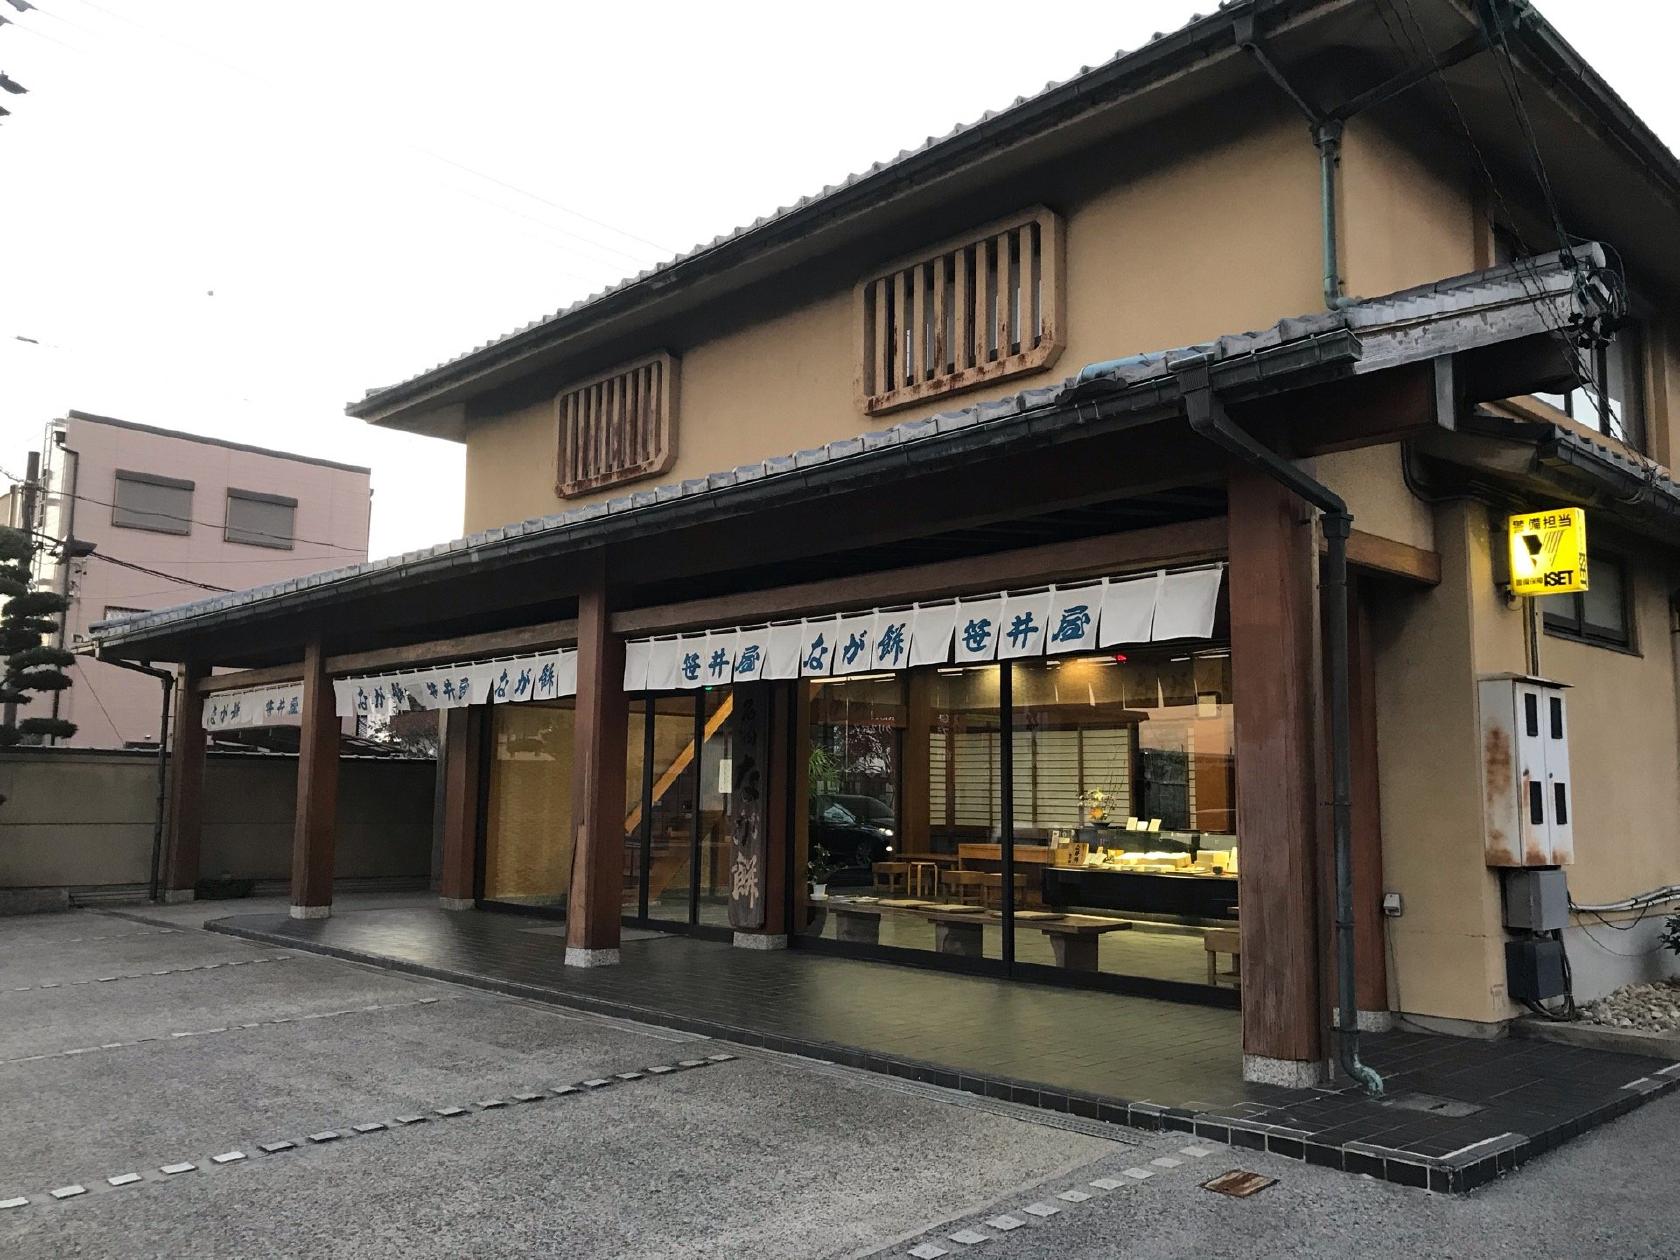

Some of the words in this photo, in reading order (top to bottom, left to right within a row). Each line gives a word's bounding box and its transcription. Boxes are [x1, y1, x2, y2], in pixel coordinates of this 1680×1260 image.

[1544, 570, 1574, 587] ISET
[682, 645, 760, 680] 笹井屋
[803, 623, 905, 671] なが餅
[962, 605, 1091, 653] 笹井屋
[495, 662, 555, 697] なが餅
